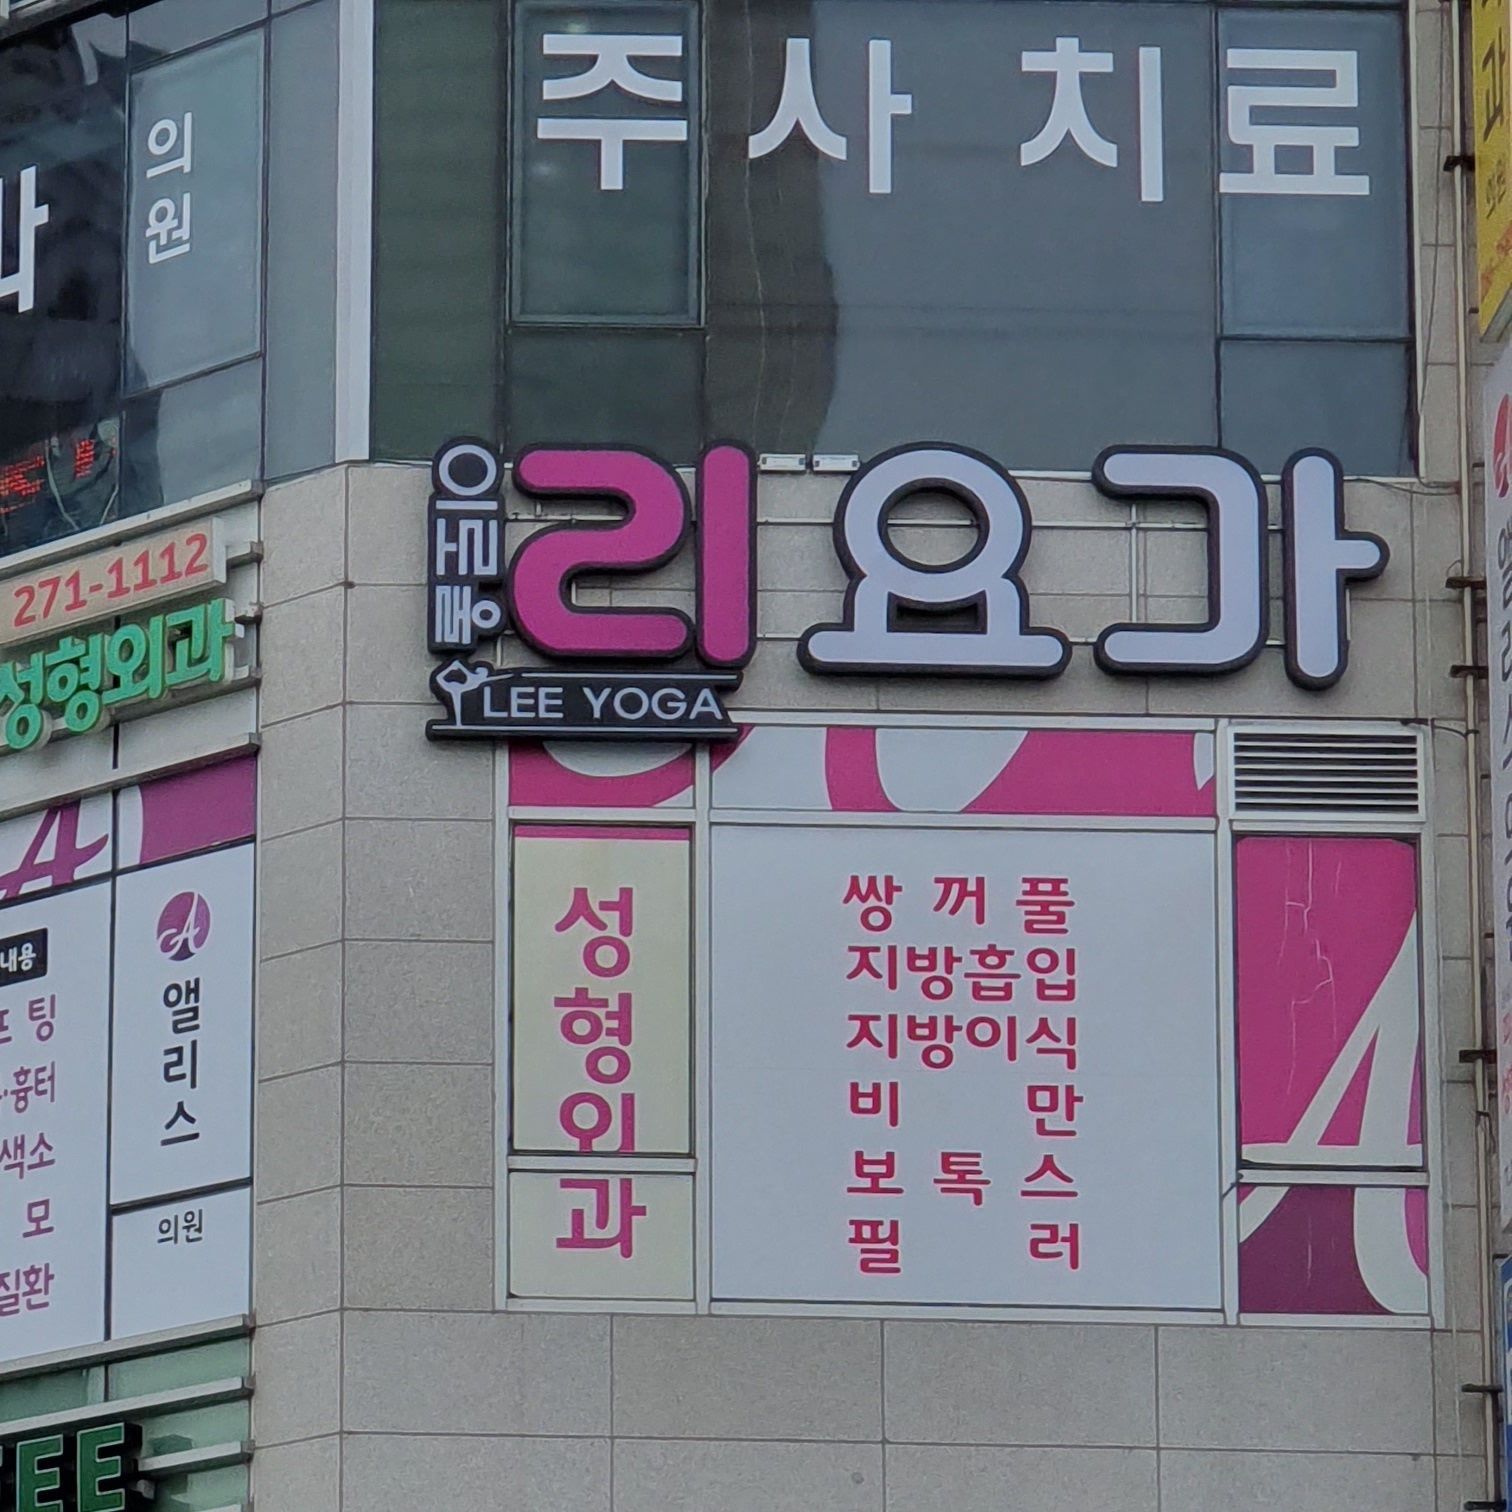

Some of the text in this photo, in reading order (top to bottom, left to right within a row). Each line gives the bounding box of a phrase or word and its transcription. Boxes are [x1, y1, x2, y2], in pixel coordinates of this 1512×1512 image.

[144, 111, 193, 264] 의원
[13, 531, 211, 627] 271-1112
[482, 685, 723, 720] LEE YOGA
[845, 943, 1080, 1003] 지방흡입
[159, 976, 202, 1148] 앨리스
[553, 886, 648, 1260] 성형외과
[845, 1012, 1080, 1071] 지방이식
[155, 1208, 205, 1246] 의원
